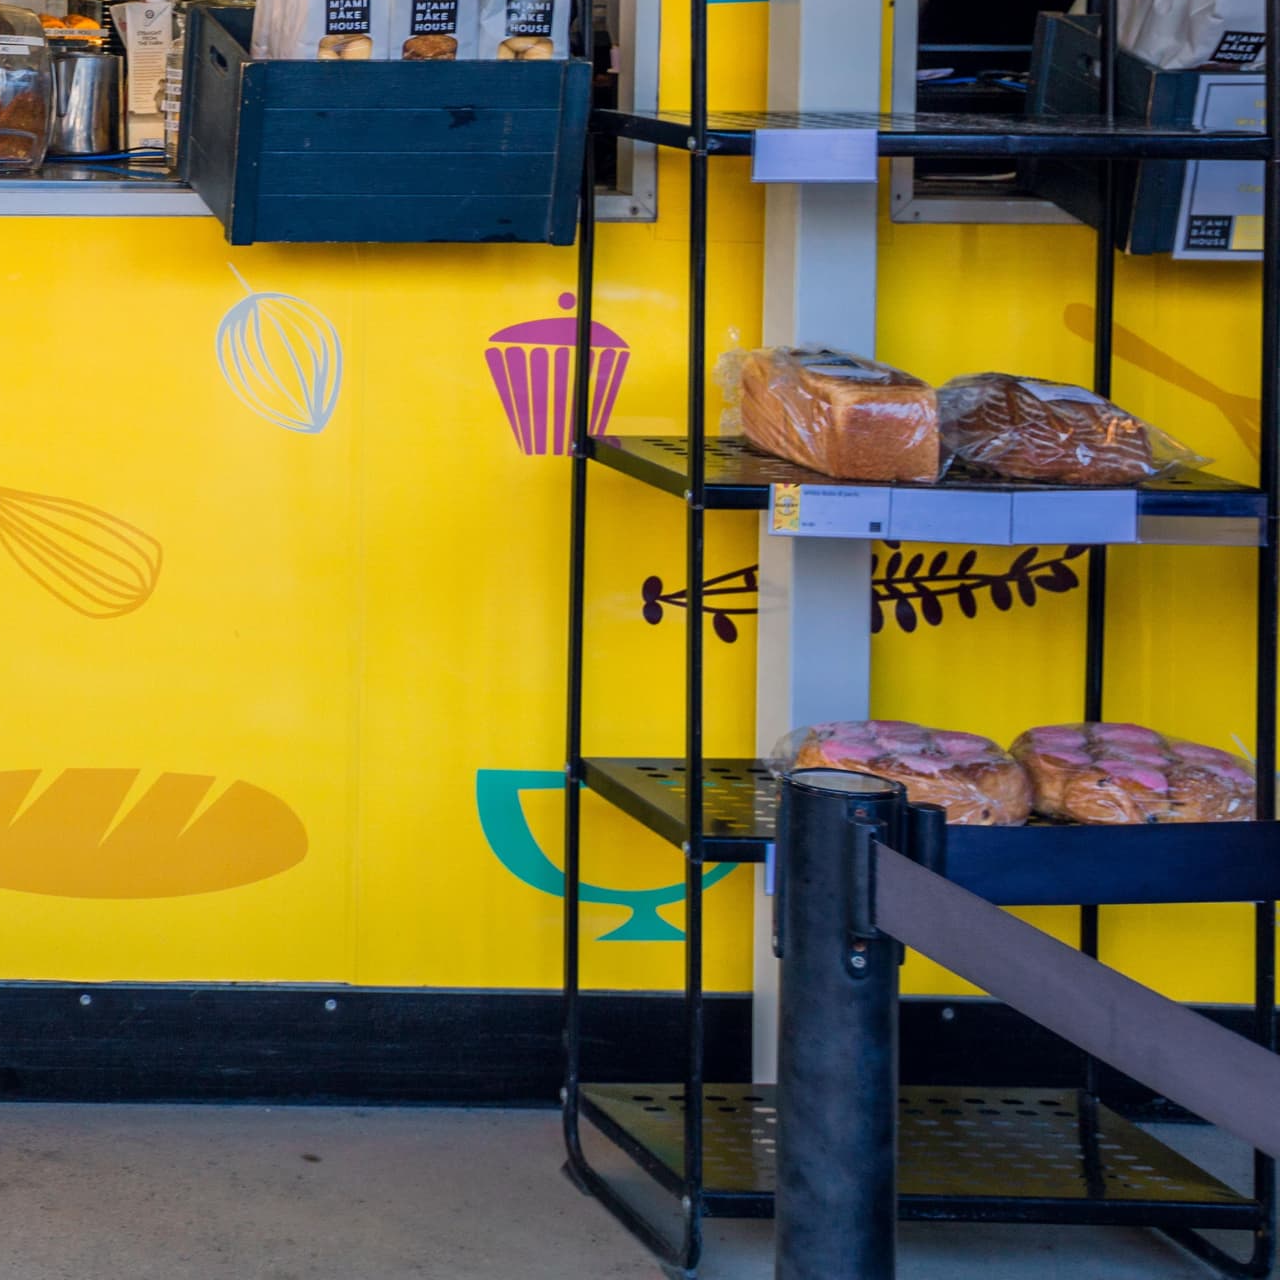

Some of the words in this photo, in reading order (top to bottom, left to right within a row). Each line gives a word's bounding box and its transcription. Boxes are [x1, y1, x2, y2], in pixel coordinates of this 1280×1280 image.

[329, 0, 368, 10] MIAMI
[415, 1, 455, 12] MIAMI
[510, 1, 551, 11] MIAMI
[329, 11, 362, 20] BAKE
[415, 12, 449, 21] BAKE
[510, 13, 544, 22] BAKE
[329, 21, 368, 31] HOUSE
[414, 22, 455, 32] HOUSE
[510, 23, 550, 33] HOUSE
[1215, 52, 1256, 61] HOUSE
